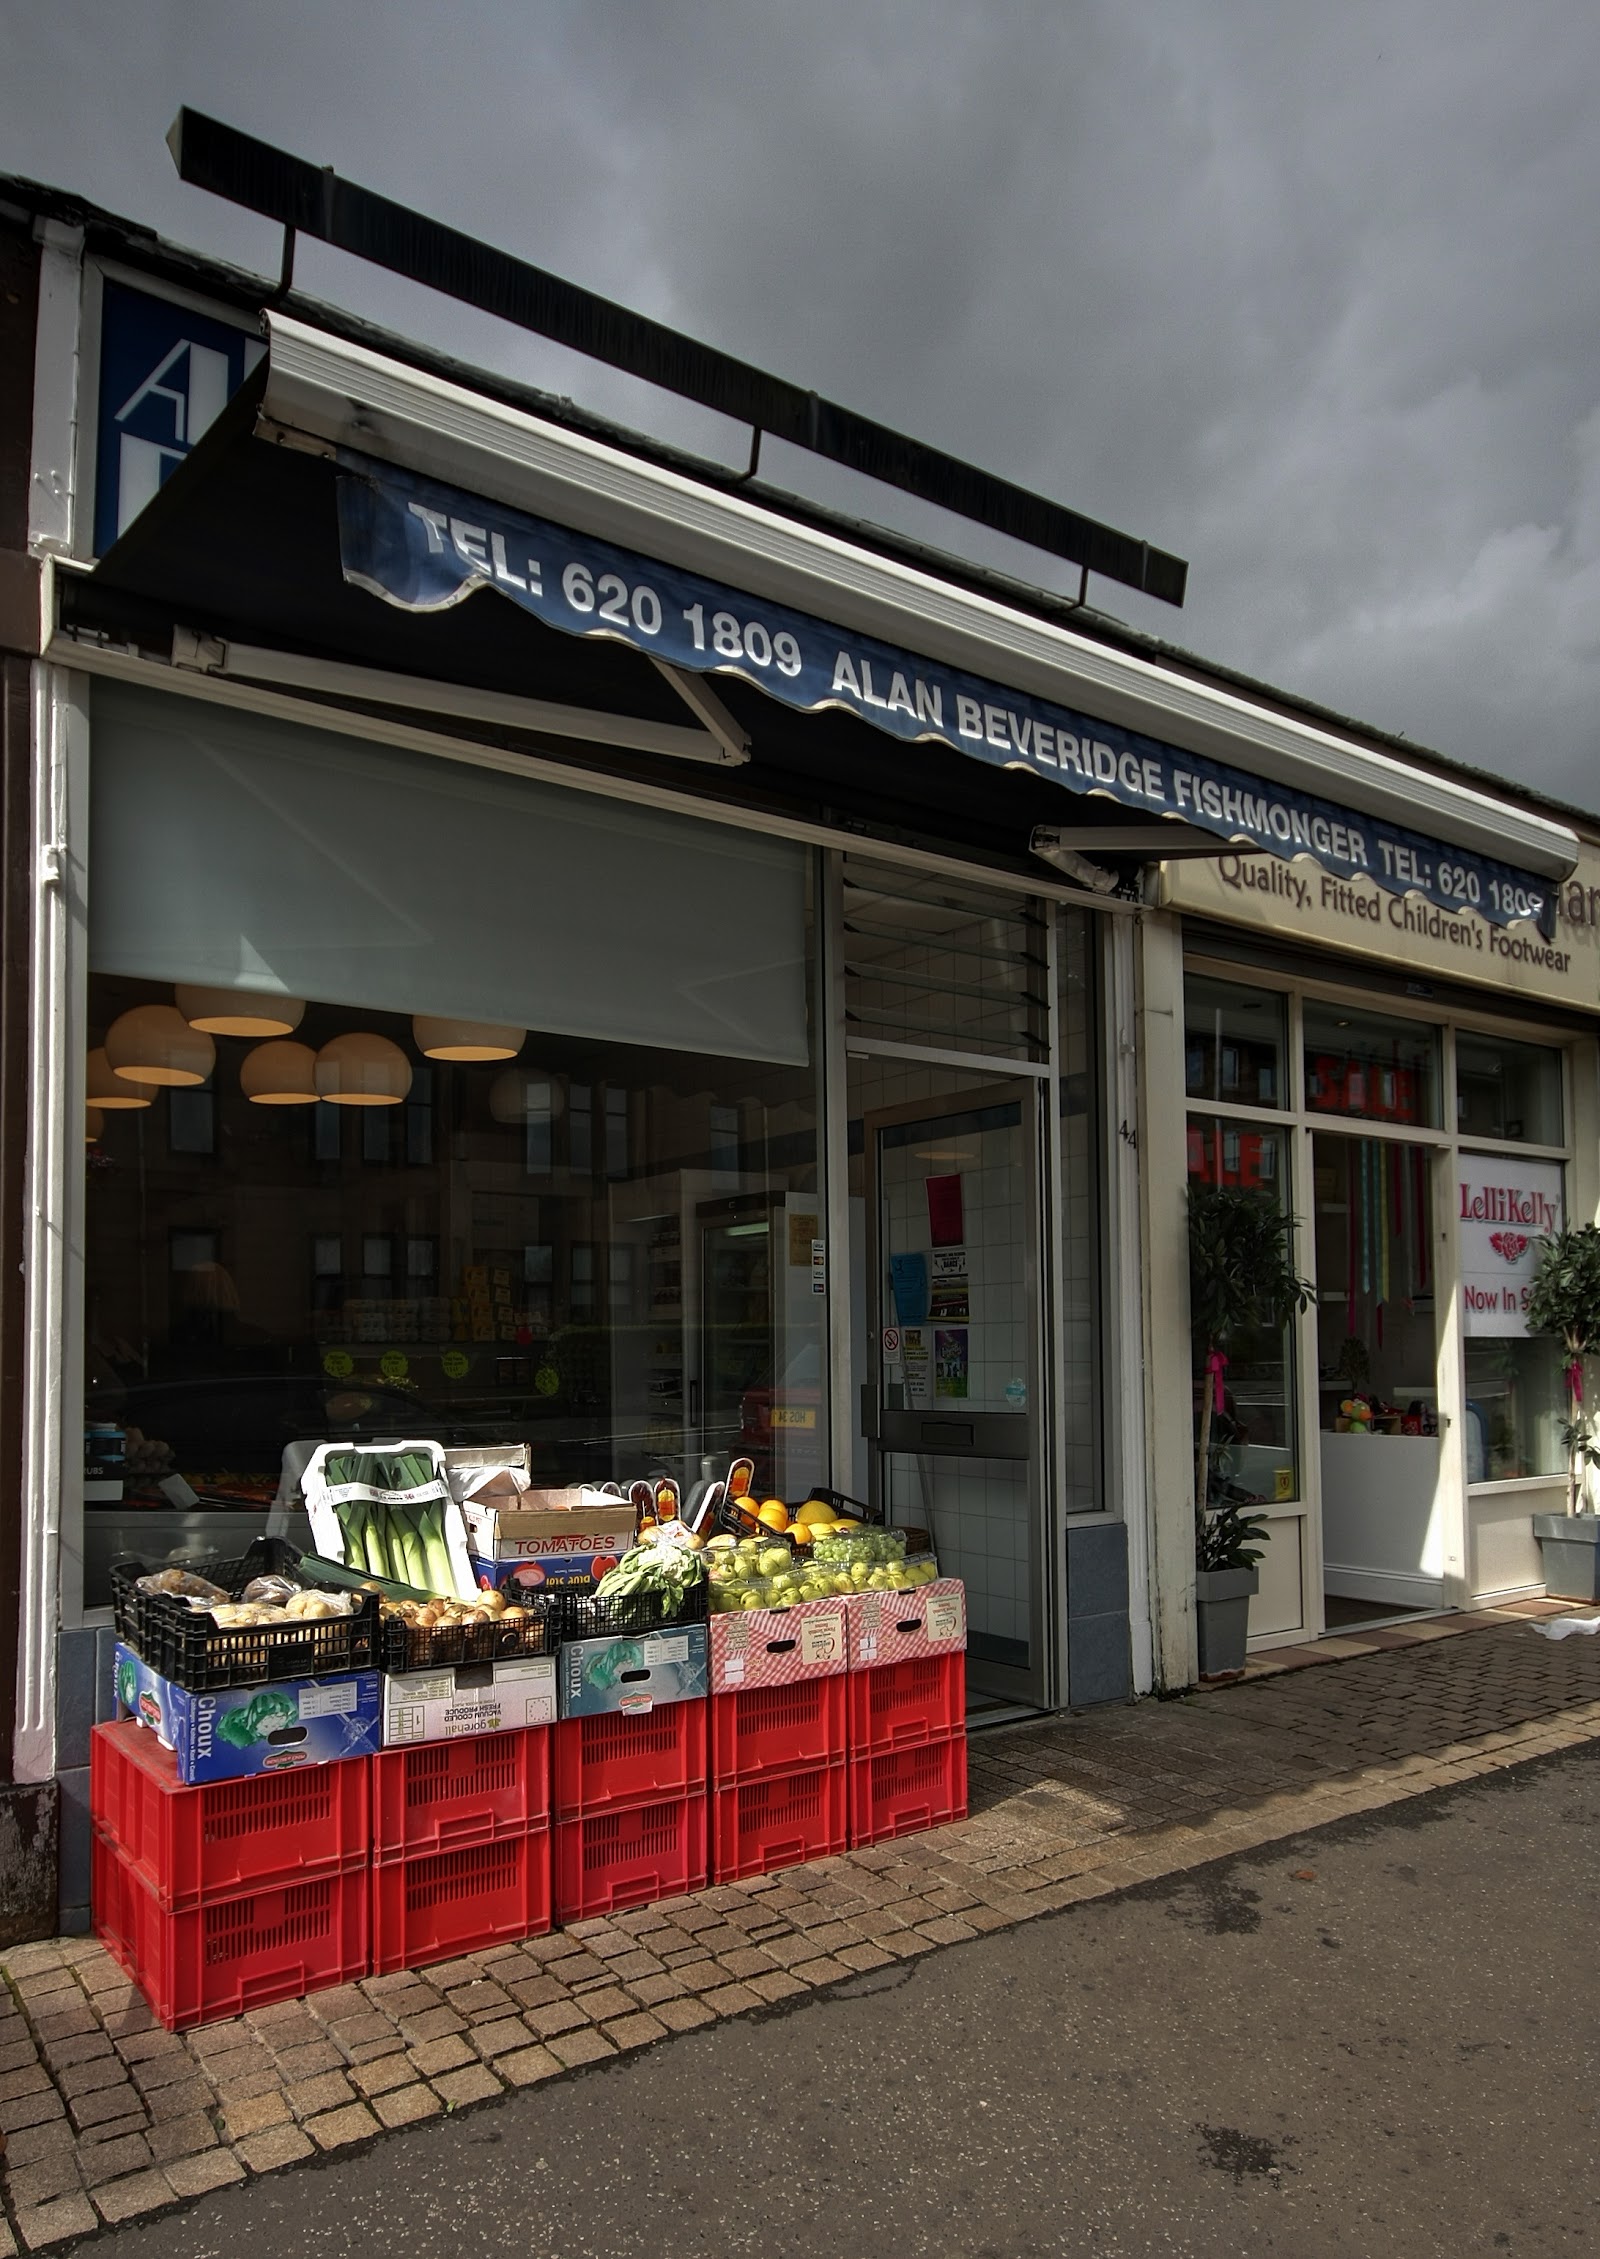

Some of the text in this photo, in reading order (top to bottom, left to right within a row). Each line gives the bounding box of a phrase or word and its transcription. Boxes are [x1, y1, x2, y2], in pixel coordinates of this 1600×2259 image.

[114, 338, 270, 446] A
[408, 501, 543, 597] TEL:
[561, 562, 663, 635] 620
[683, 602, 802, 677] 1809
[831, 650, 945, 728] ALAN
[956, 693, 1166, 800] BEVERIDGE
[1173, 769, 1369, 867] FISHMONGER
[1377, 840, 1433, 888] TEL:
[1437, 862, 1481, 903] 620
[1218, 856, 1571, 974] Quality, Fitted Children's Footwear
[1464, 1285, 1498, 1311] Now
[1503, 1286, 1516, 1311] In
[515, 1535, 615, 1555] TOMATOES
[570, 1645, 584, 1699] Choux
[197, 1696, 217, 1759] Choux
[444, 1710, 502, 1722] VACUUM COOLED
[445, 1703, 501, 1715] FRESH PRODUCE
[445, 1719, 487, 1735] gorehall
